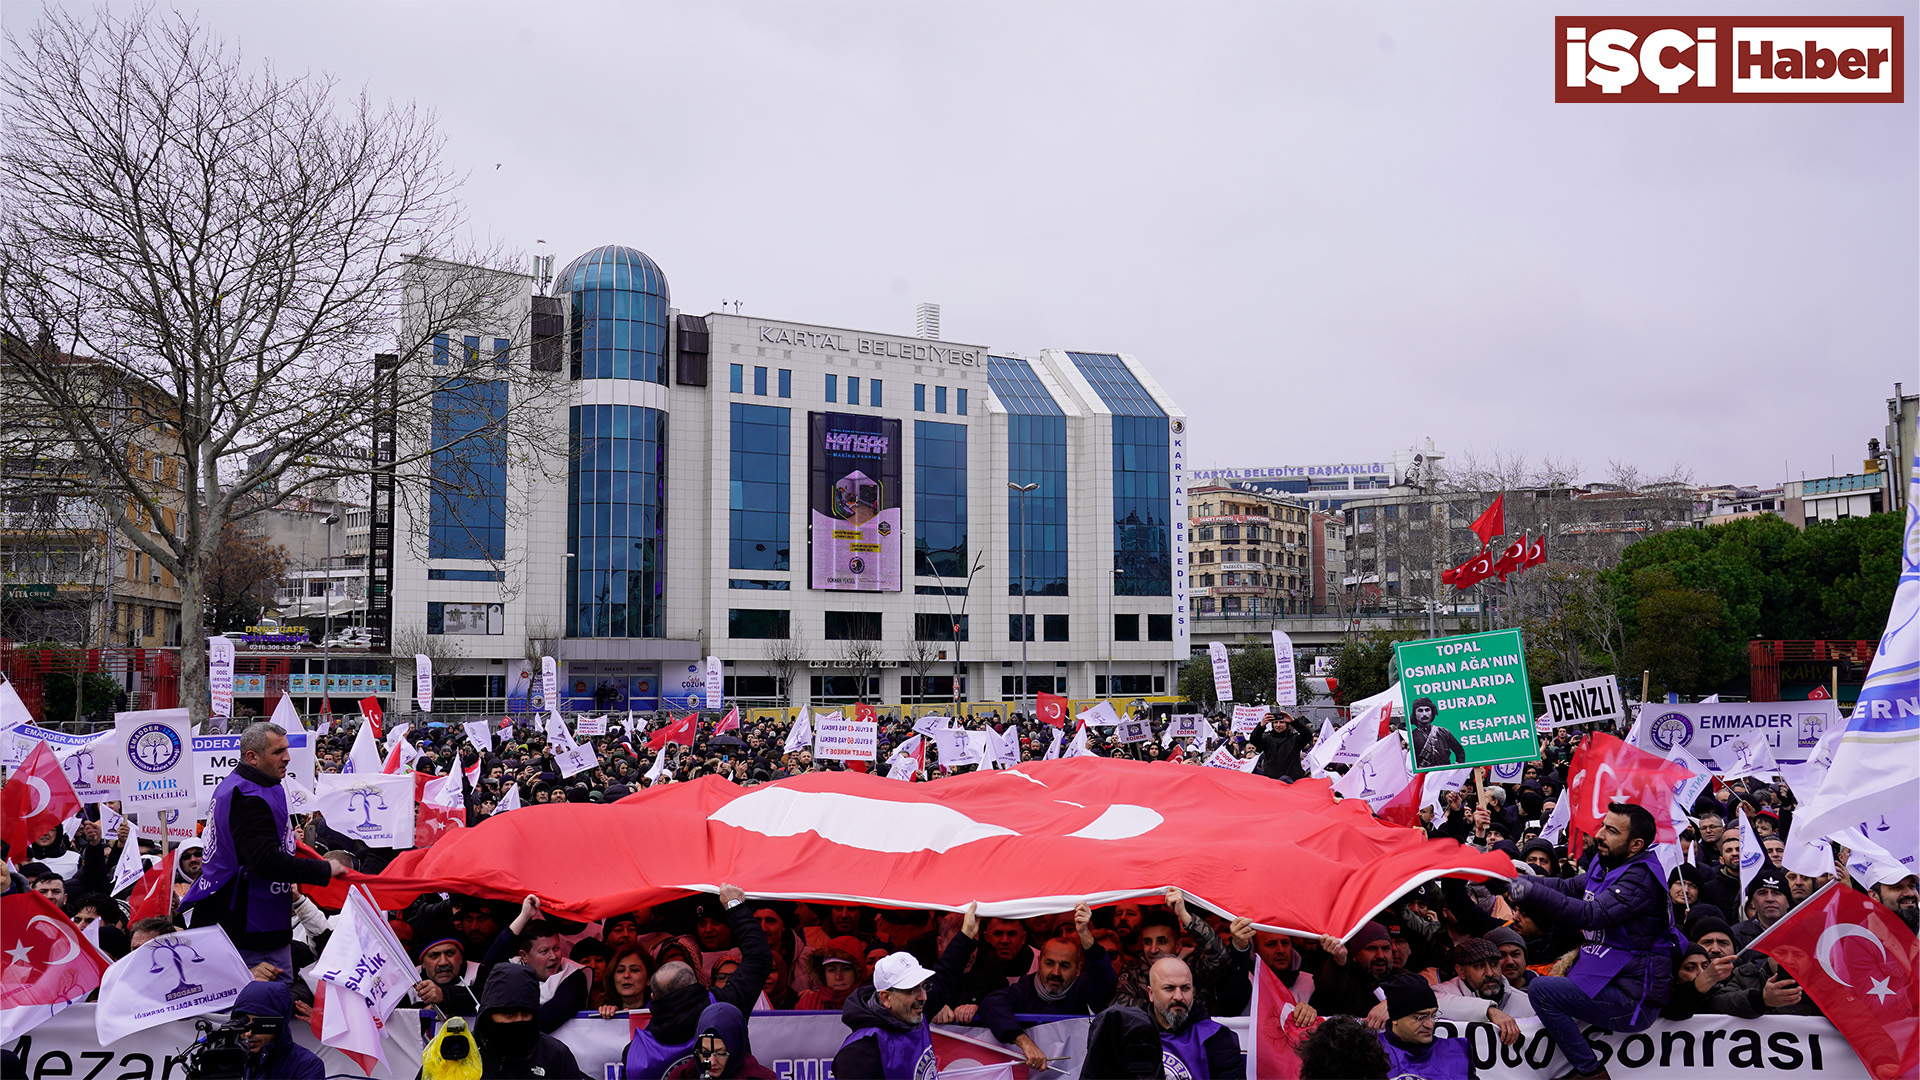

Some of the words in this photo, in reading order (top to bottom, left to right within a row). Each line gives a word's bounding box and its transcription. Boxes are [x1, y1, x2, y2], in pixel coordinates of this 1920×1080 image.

[759, 326, 850, 351] KARTAL
[858, 337, 981, 367] BELEDİYESİ
[1174, 439, 1182, 506] KARTAL
[1194, 470, 1241, 480] KARTAL
[1244, 465, 1304, 478] BELEDİYE
[1308, 462, 1385, 476] BAŞKANLIĞI
[1176, 522, 1185, 637] BELEDİYESİ
[1435, 641, 1481, 657] TOPAL
[1405, 661, 1457, 679] OSMAN
[1413, 672, 1515, 696] TORUNLARIDA
[1437, 693, 1497, 711] BURADA
[1549, 678, 1617, 723] DENİZLİ
[1459, 713, 1527, 732] KEŞAPTAN
[1700, 714, 1793, 729] EMMADER
[24, 727, 66, 743] EMADDER
[1460, 728, 1530, 746] SELAMLAR
[137, 776, 177, 791] İZMİR
[128, 788, 188, 802] TEMSİLCİLİĞİ
[1581, 1025, 1824, 1071] Sonrası
